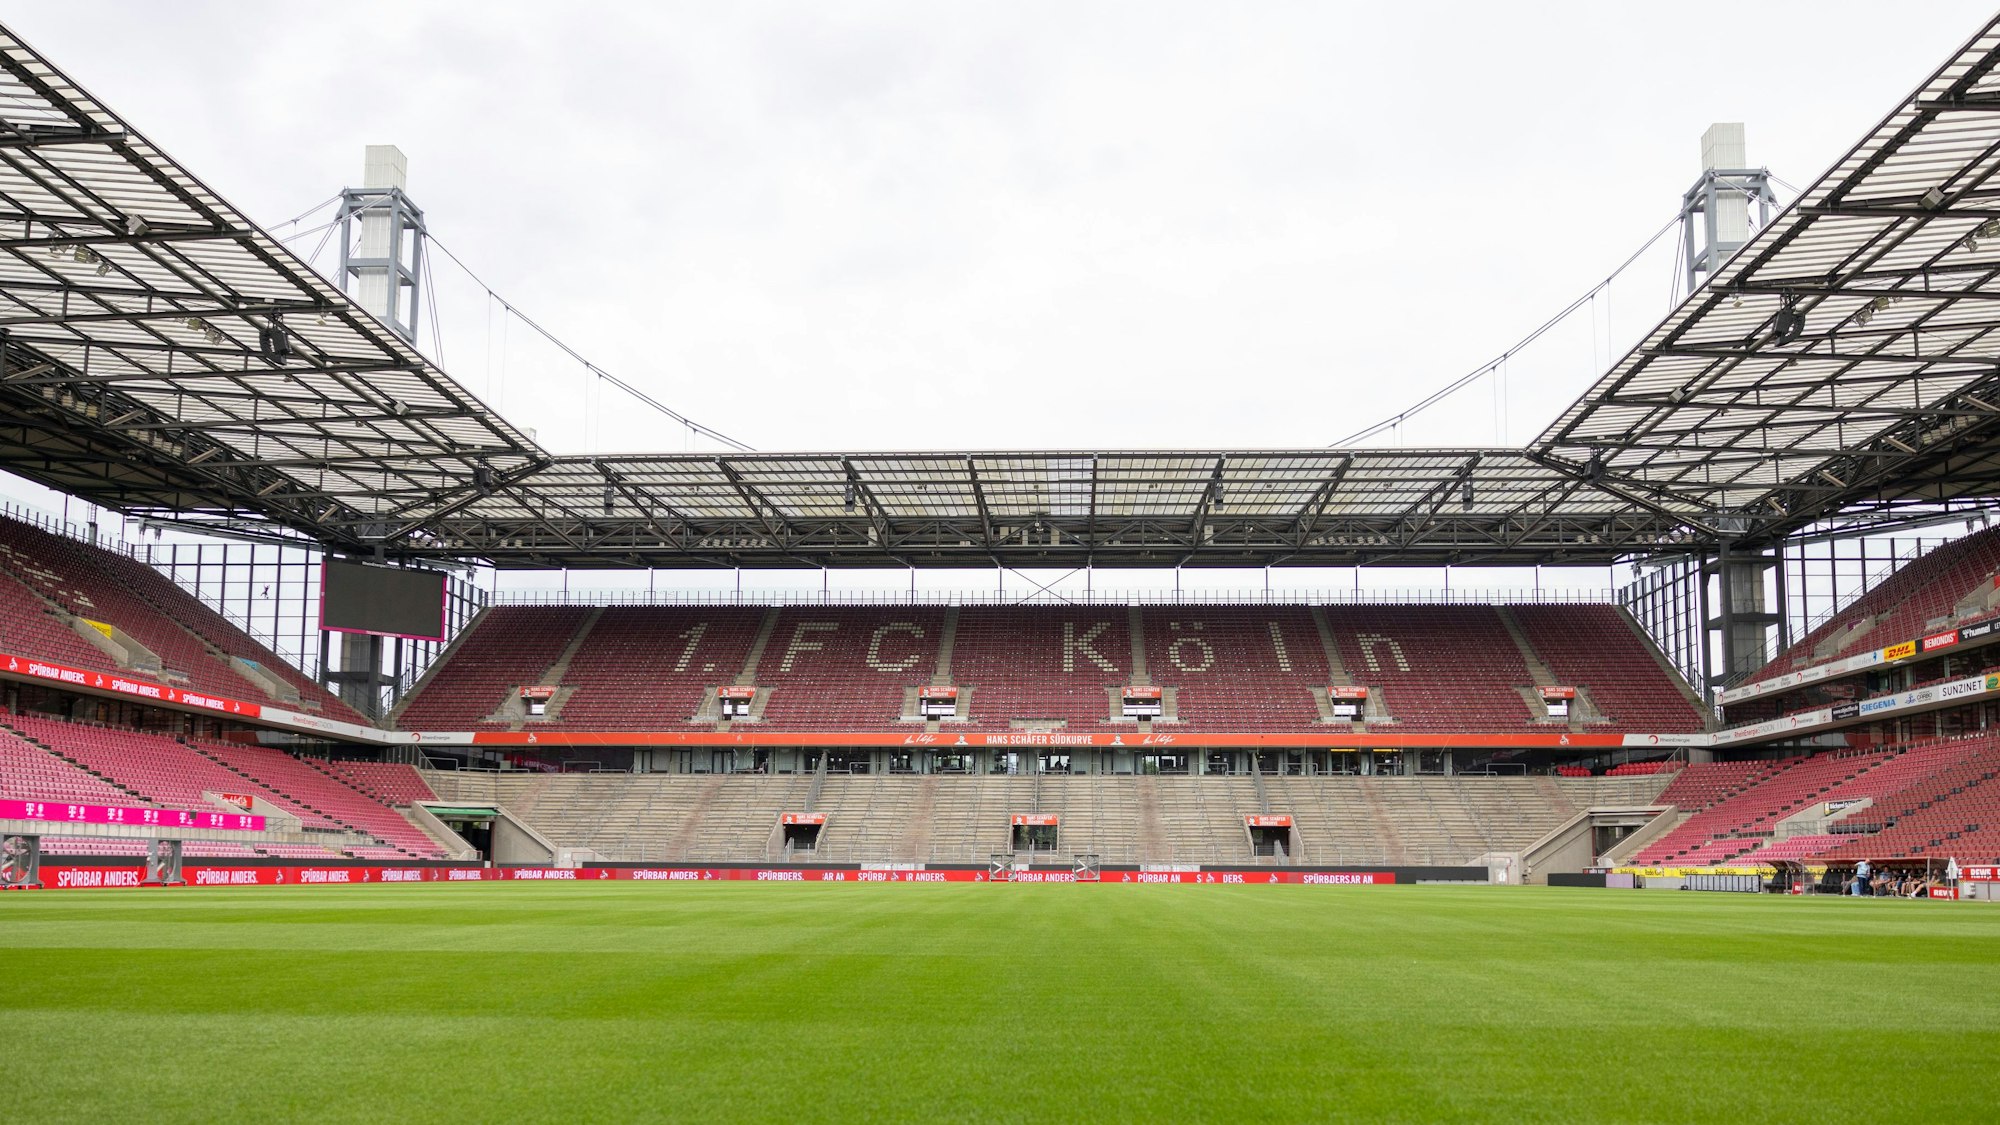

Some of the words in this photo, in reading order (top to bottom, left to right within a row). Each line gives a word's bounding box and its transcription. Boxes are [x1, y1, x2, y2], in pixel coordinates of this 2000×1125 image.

[1969, 623, 1991, 637] hummel
[674, 622, 715, 671] 1.
[780, 622, 925, 671] FC
[1924, 632, 1956, 649] REMONDIS
[1888, 644, 1911, 658] DHL
[28, 663, 59, 678] SPÜRBAR
[60, 669, 85, 684] ANDERS.
[112, 680, 138, 692] SPÜRBAR
[139, 685, 160, 698] ANDERS.
[1942, 680, 1982, 697] SUNZINET
[182, 693, 205, 705] SPÜRBAR
[206, 698, 224, 710] ANDERS.
[1861, 699, 1896, 712] SIEGENIA
[986, 735, 1008, 745] HANS
[1010, 733, 1047, 745] SCHÄFER
[1050, 733, 1092, 745] SÜDKURVE
[57, 868, 102, 887] SPÜRBAR
[104, 871, 140, 886] ANDERS.
[196, 868, 229, 884] SPÜRBAR
[230, 871, 258, 884] ANDERS.
[301, 868, 327, 883] SPÜRBAR
[328, 870, 350, 882] ANDERS.
[381, 868, 401, 881] SPÜRBAR
[401, 870, 421, 881] ANDERS.
[449, 868, 467, 880] SPÜRBAR
[467, 870, 482, 880] ANDERS.
[514, 868, 542, 880] SPÜRBAR
[544, 870, 576, 880] ANDERS.
[633, 869, 667, 880] SPÜRBAR
[669, 871, 698, 880] ANDERS
[915, 873, 947, 882] ANDERS.
[1138, 873, 1168, 883] PÜRBAR
[1170, 874, 1180, 883] AN
[1223, 874, 1245, 883] DERS.
